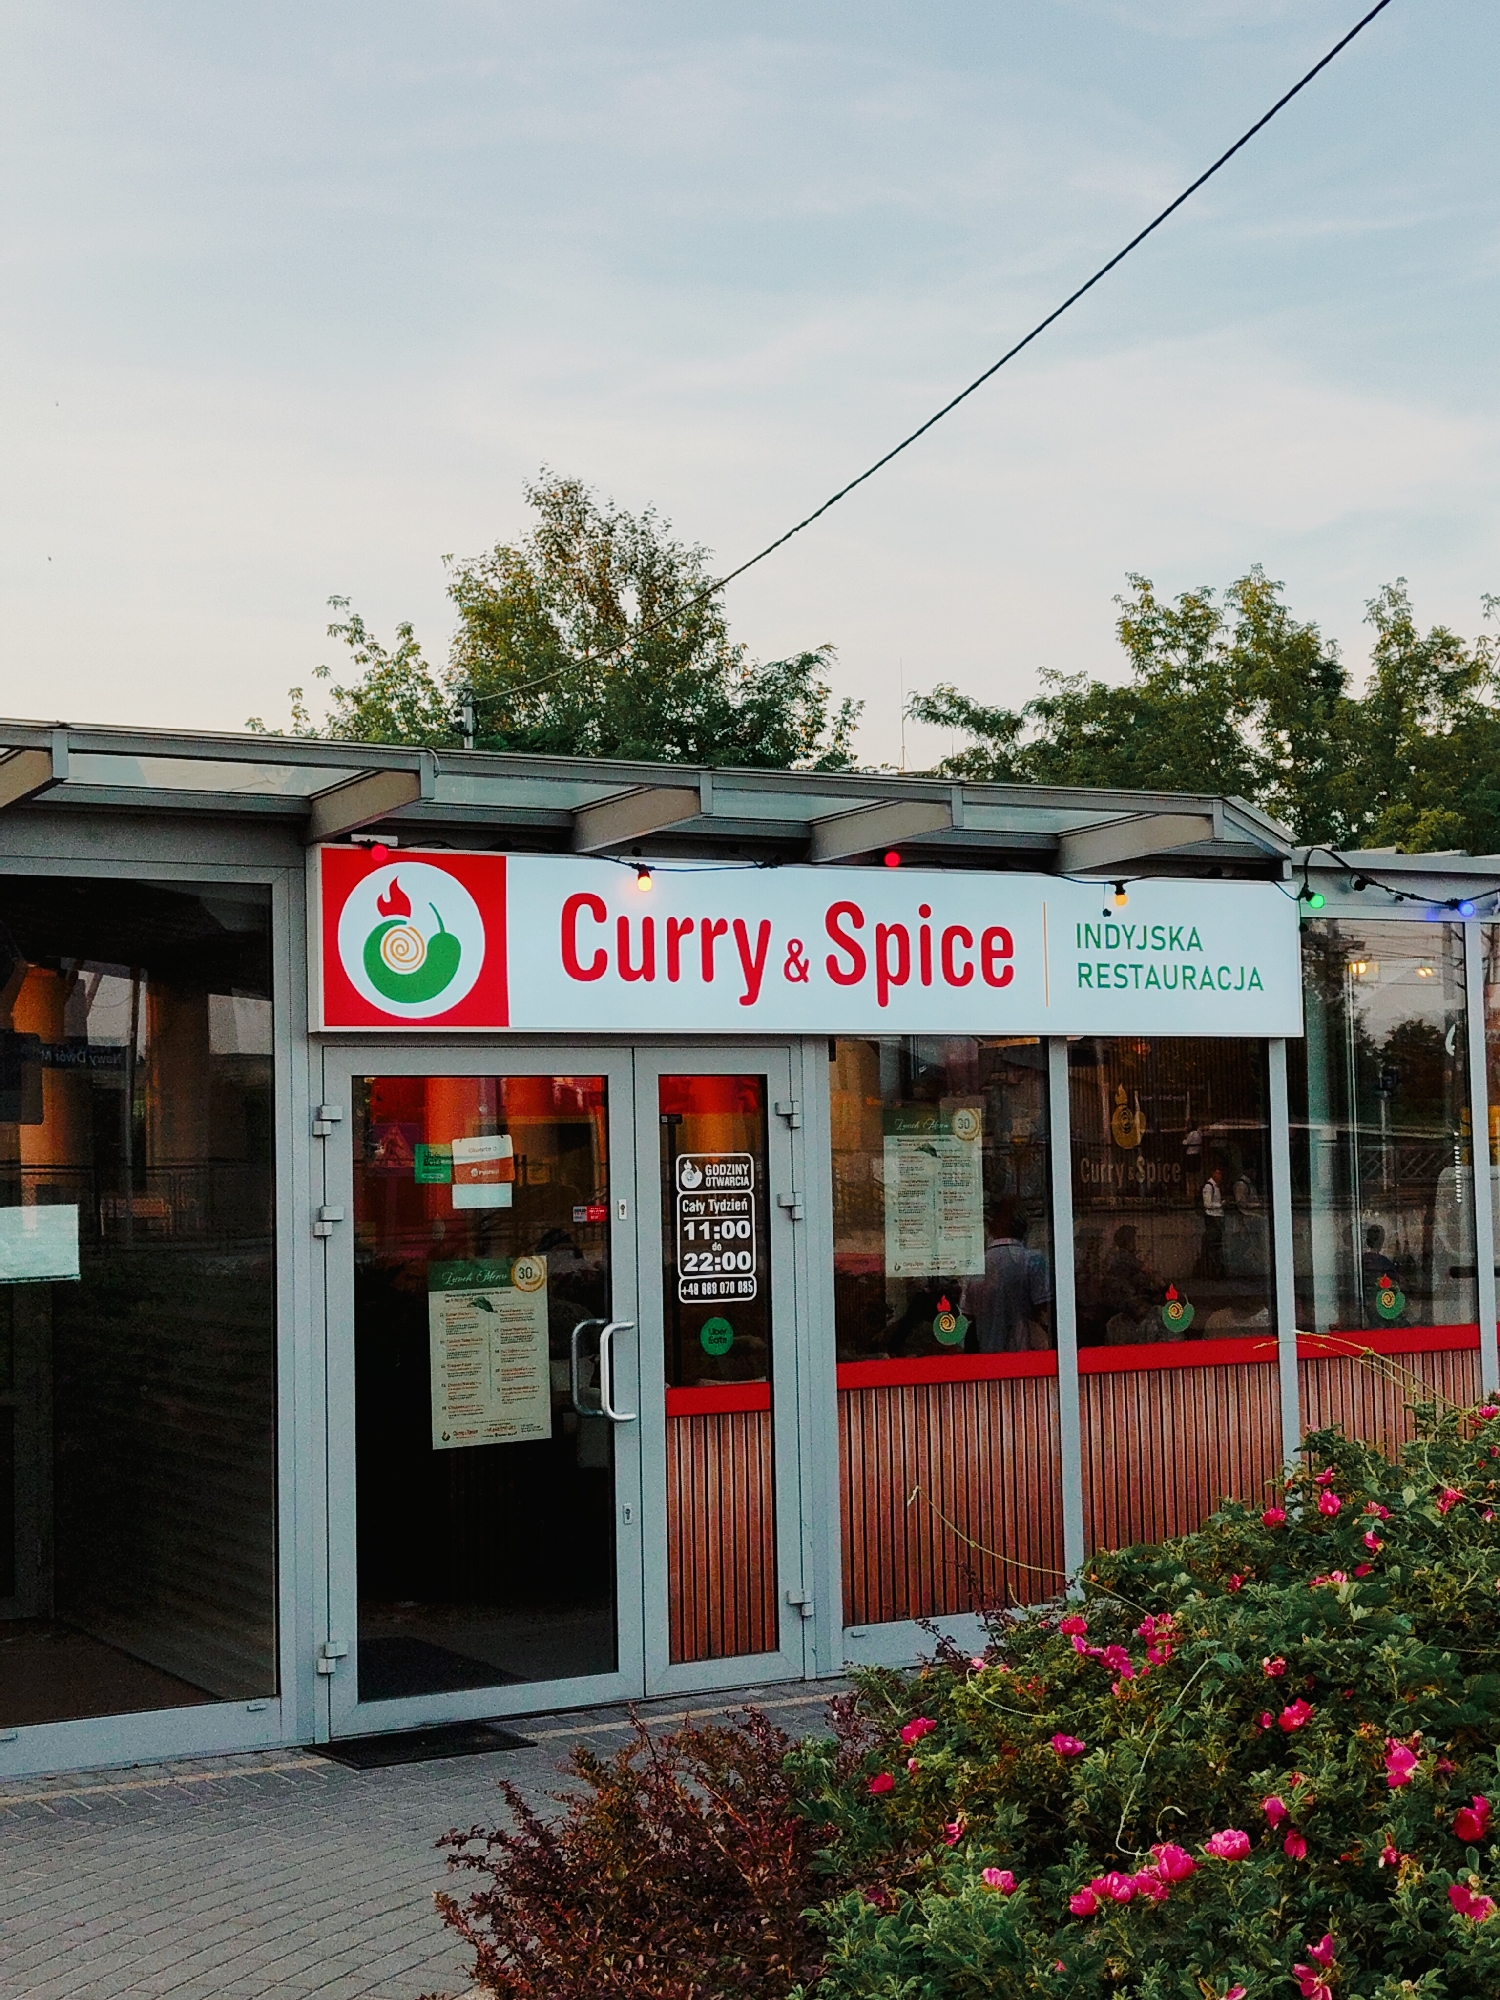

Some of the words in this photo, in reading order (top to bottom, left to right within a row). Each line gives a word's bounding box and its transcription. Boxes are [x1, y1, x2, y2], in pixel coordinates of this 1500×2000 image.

[1075, 922, 1203, 952] INDYJSKA
[560, 892, 772, 1007] Curry
[783, 938, 810, 983] &
[824, 900, 1015, 1008] Spice
[1077, 961, 1264, 992] RESTAURACJA
[957, 1117, 971, 1129] 30
[704, 1163, 749, 1176] GODZINY
[1080, 1157, 1125, 1189] Curry
[1135, 1155, 1182, 1190] Spice
[705, 1176, 750, 1188] OTWARCIA
[682, 1199, 706, 1215] Cały
[708, 1198, 748, 1216] Tydzień
[683, 1220, 751, 1241] 11:00
[711, 1242, 722, 1252] do
[683, 1251, 752, 1272] 22:00
[518, 1266, 532, 1280] 30
